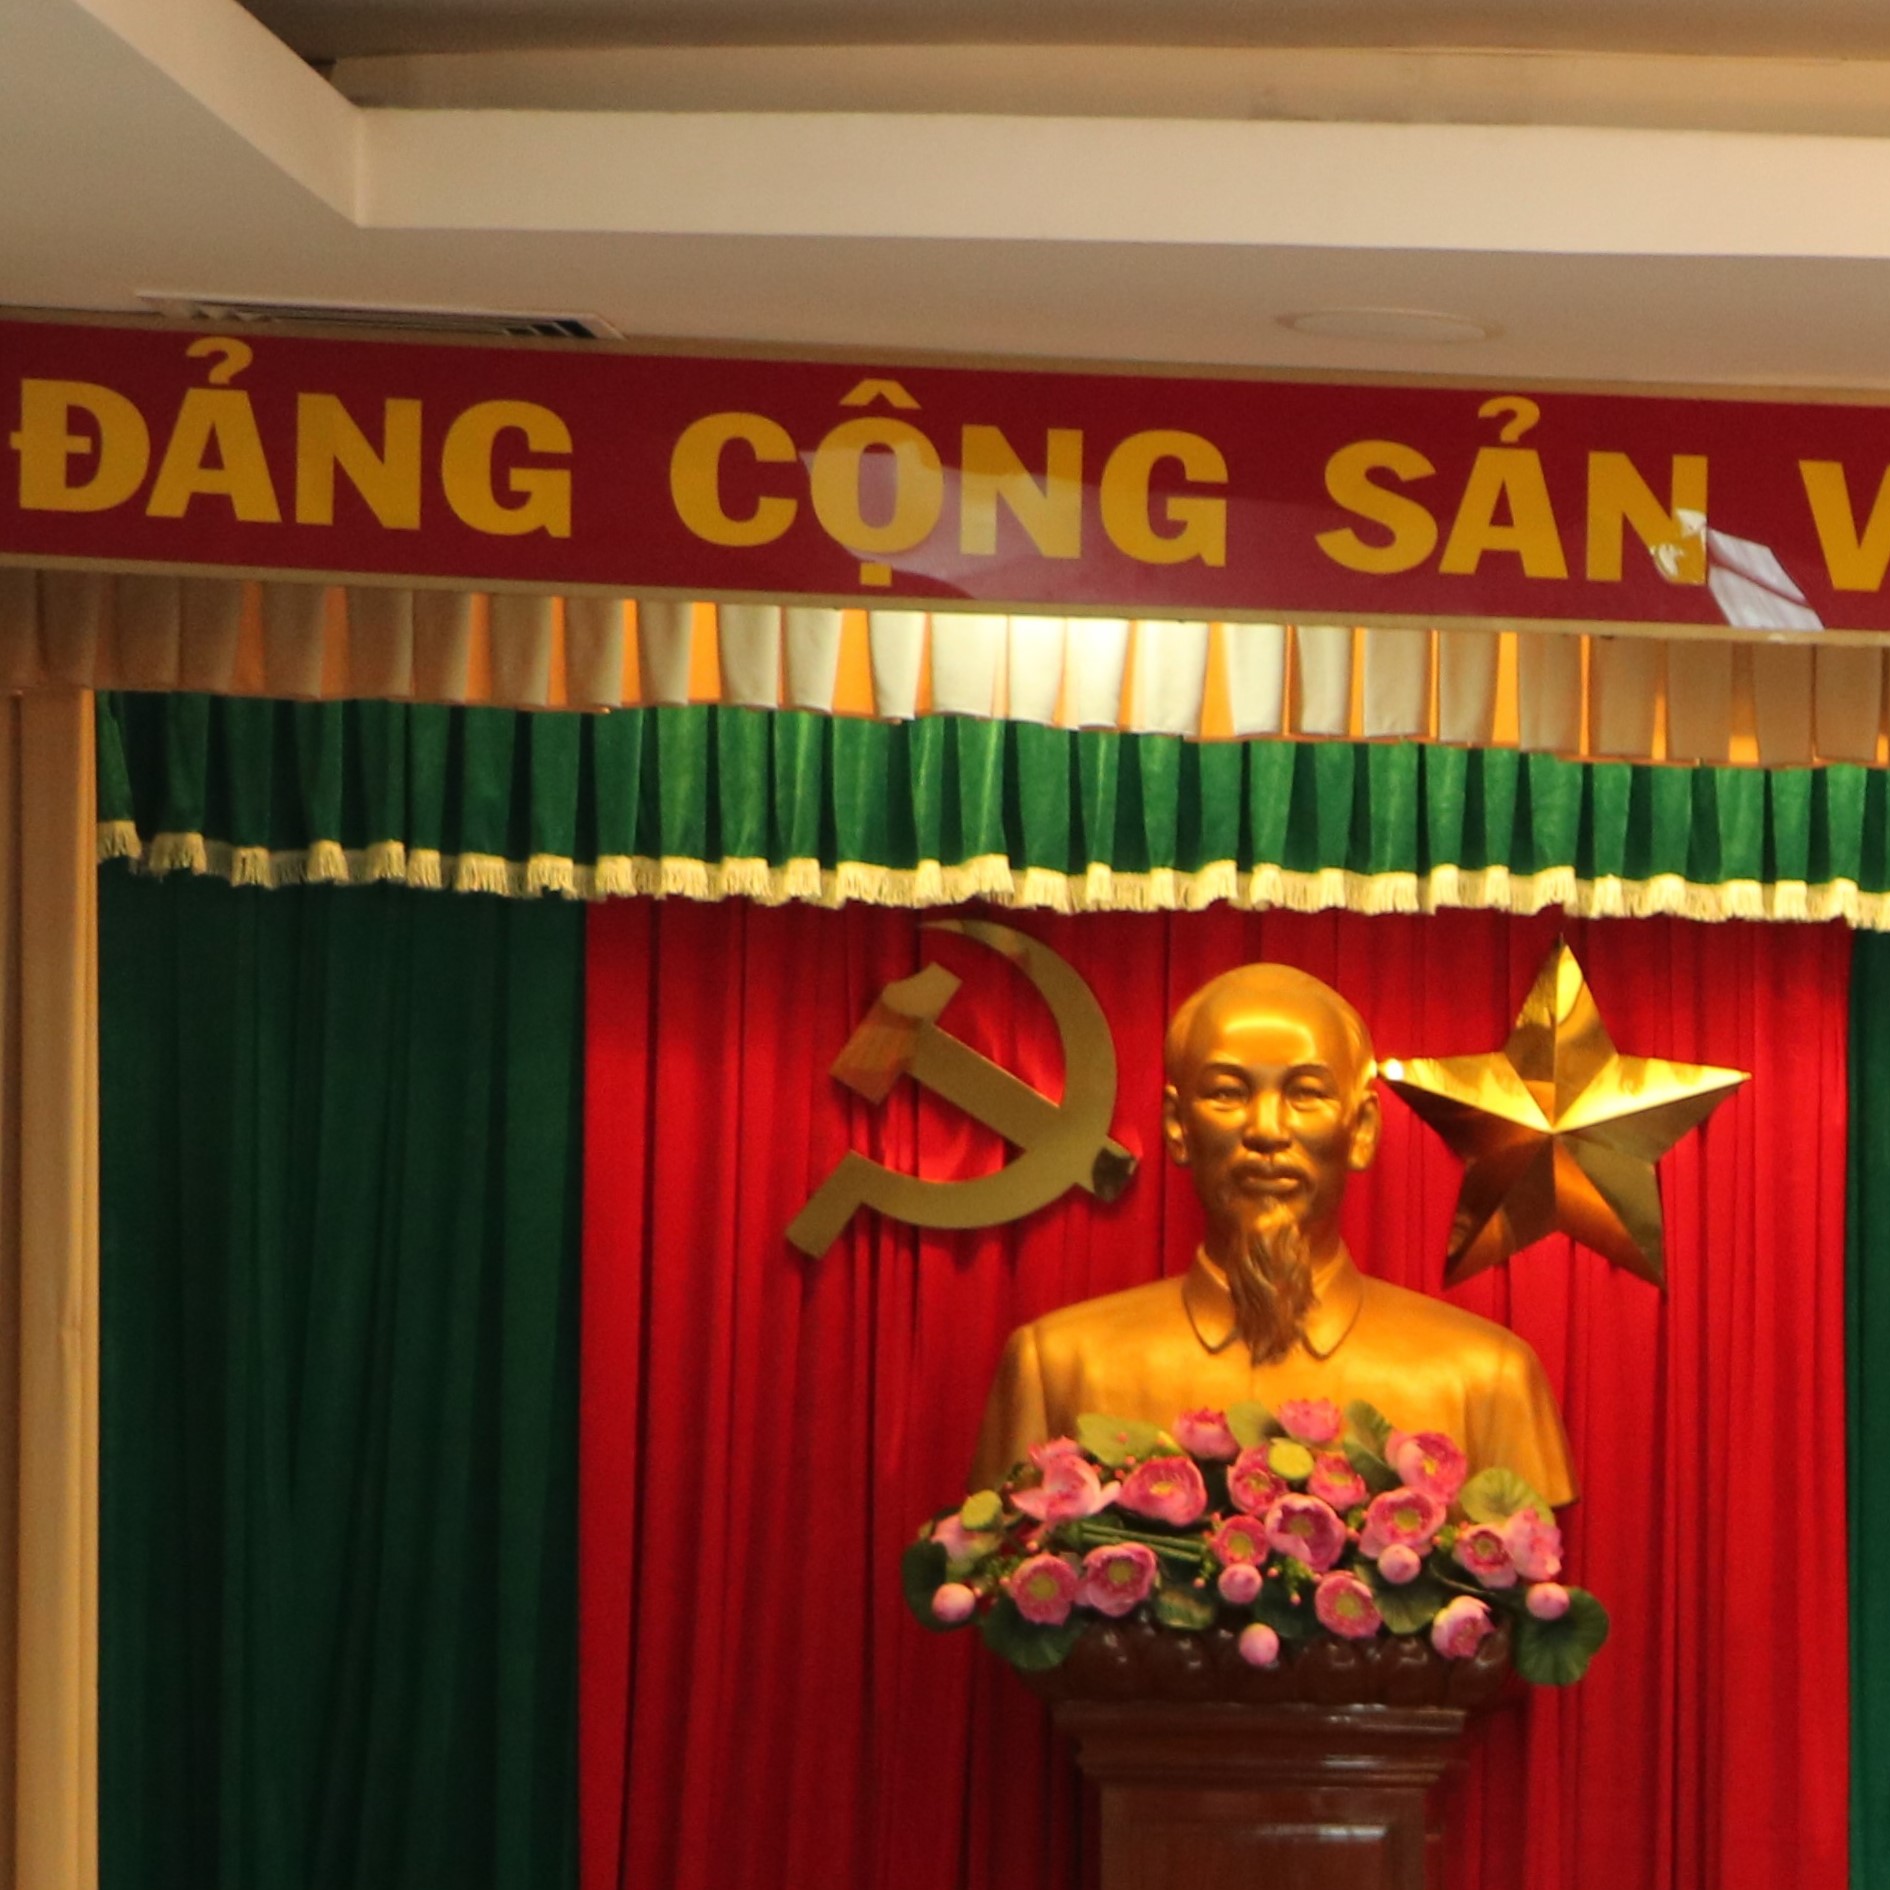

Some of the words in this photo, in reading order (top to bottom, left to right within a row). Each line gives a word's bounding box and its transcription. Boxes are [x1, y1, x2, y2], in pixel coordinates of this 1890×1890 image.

[10, 336, 573, 538] ĐẢNG
[669, 379, 1229, 587] CỘNG
[1313, 395, 1708, 584] SẢN
